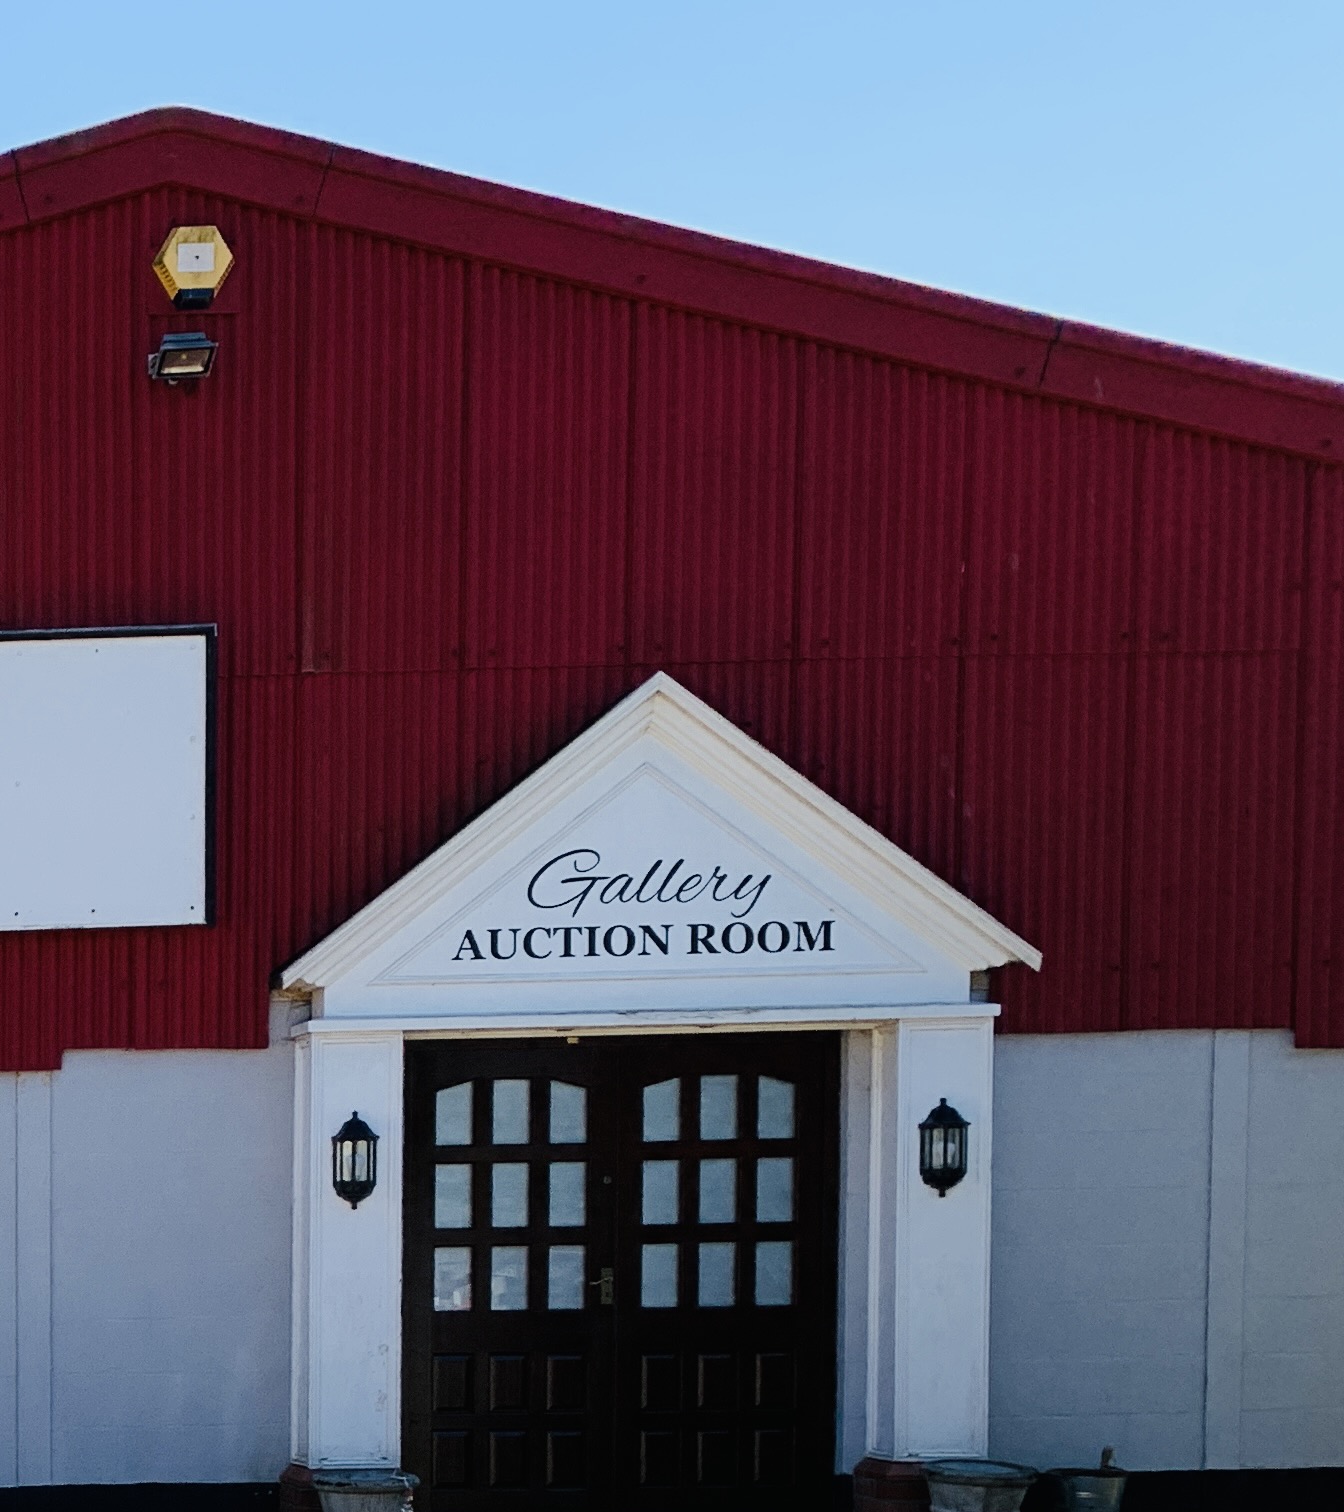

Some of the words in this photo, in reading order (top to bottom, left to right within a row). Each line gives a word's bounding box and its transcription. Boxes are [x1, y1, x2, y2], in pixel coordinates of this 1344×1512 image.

[526, 849, 773, 918] Gallery
[451, 923, 671, 961] AUCTION
[687, 919, 836, 956] ROOM
